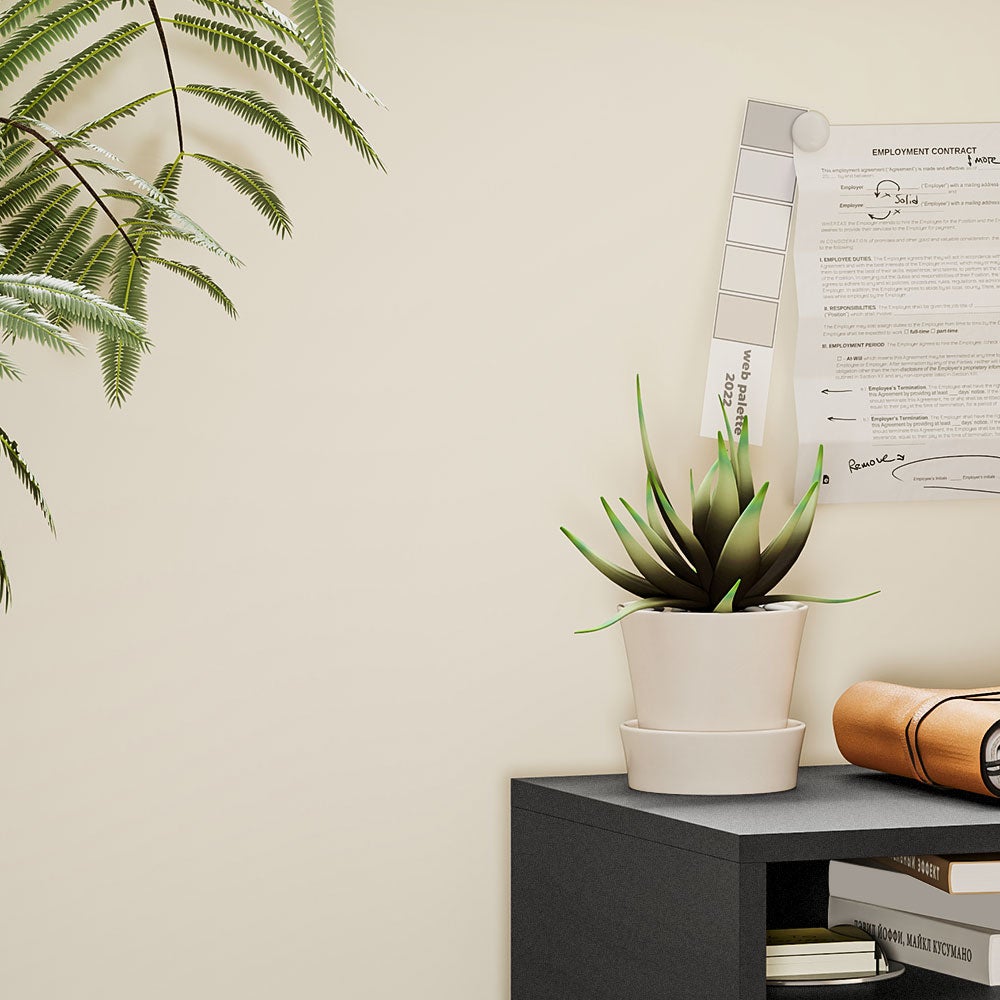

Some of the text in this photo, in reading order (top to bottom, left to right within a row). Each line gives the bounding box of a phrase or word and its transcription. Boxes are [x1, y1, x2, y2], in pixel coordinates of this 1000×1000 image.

[872, 147, 977, 156] EMPLOYMENT CONTRACT
[895, 193, 918, 205] Solid
[723, 372, 735, 407] 2022
[734, 349, 752, 436] web palette
[848, 453, 896, 474] Remove
[906, 933, 932, 951] МАЙКЛ
[932, 940, 973, 962] КУСУМАНО
